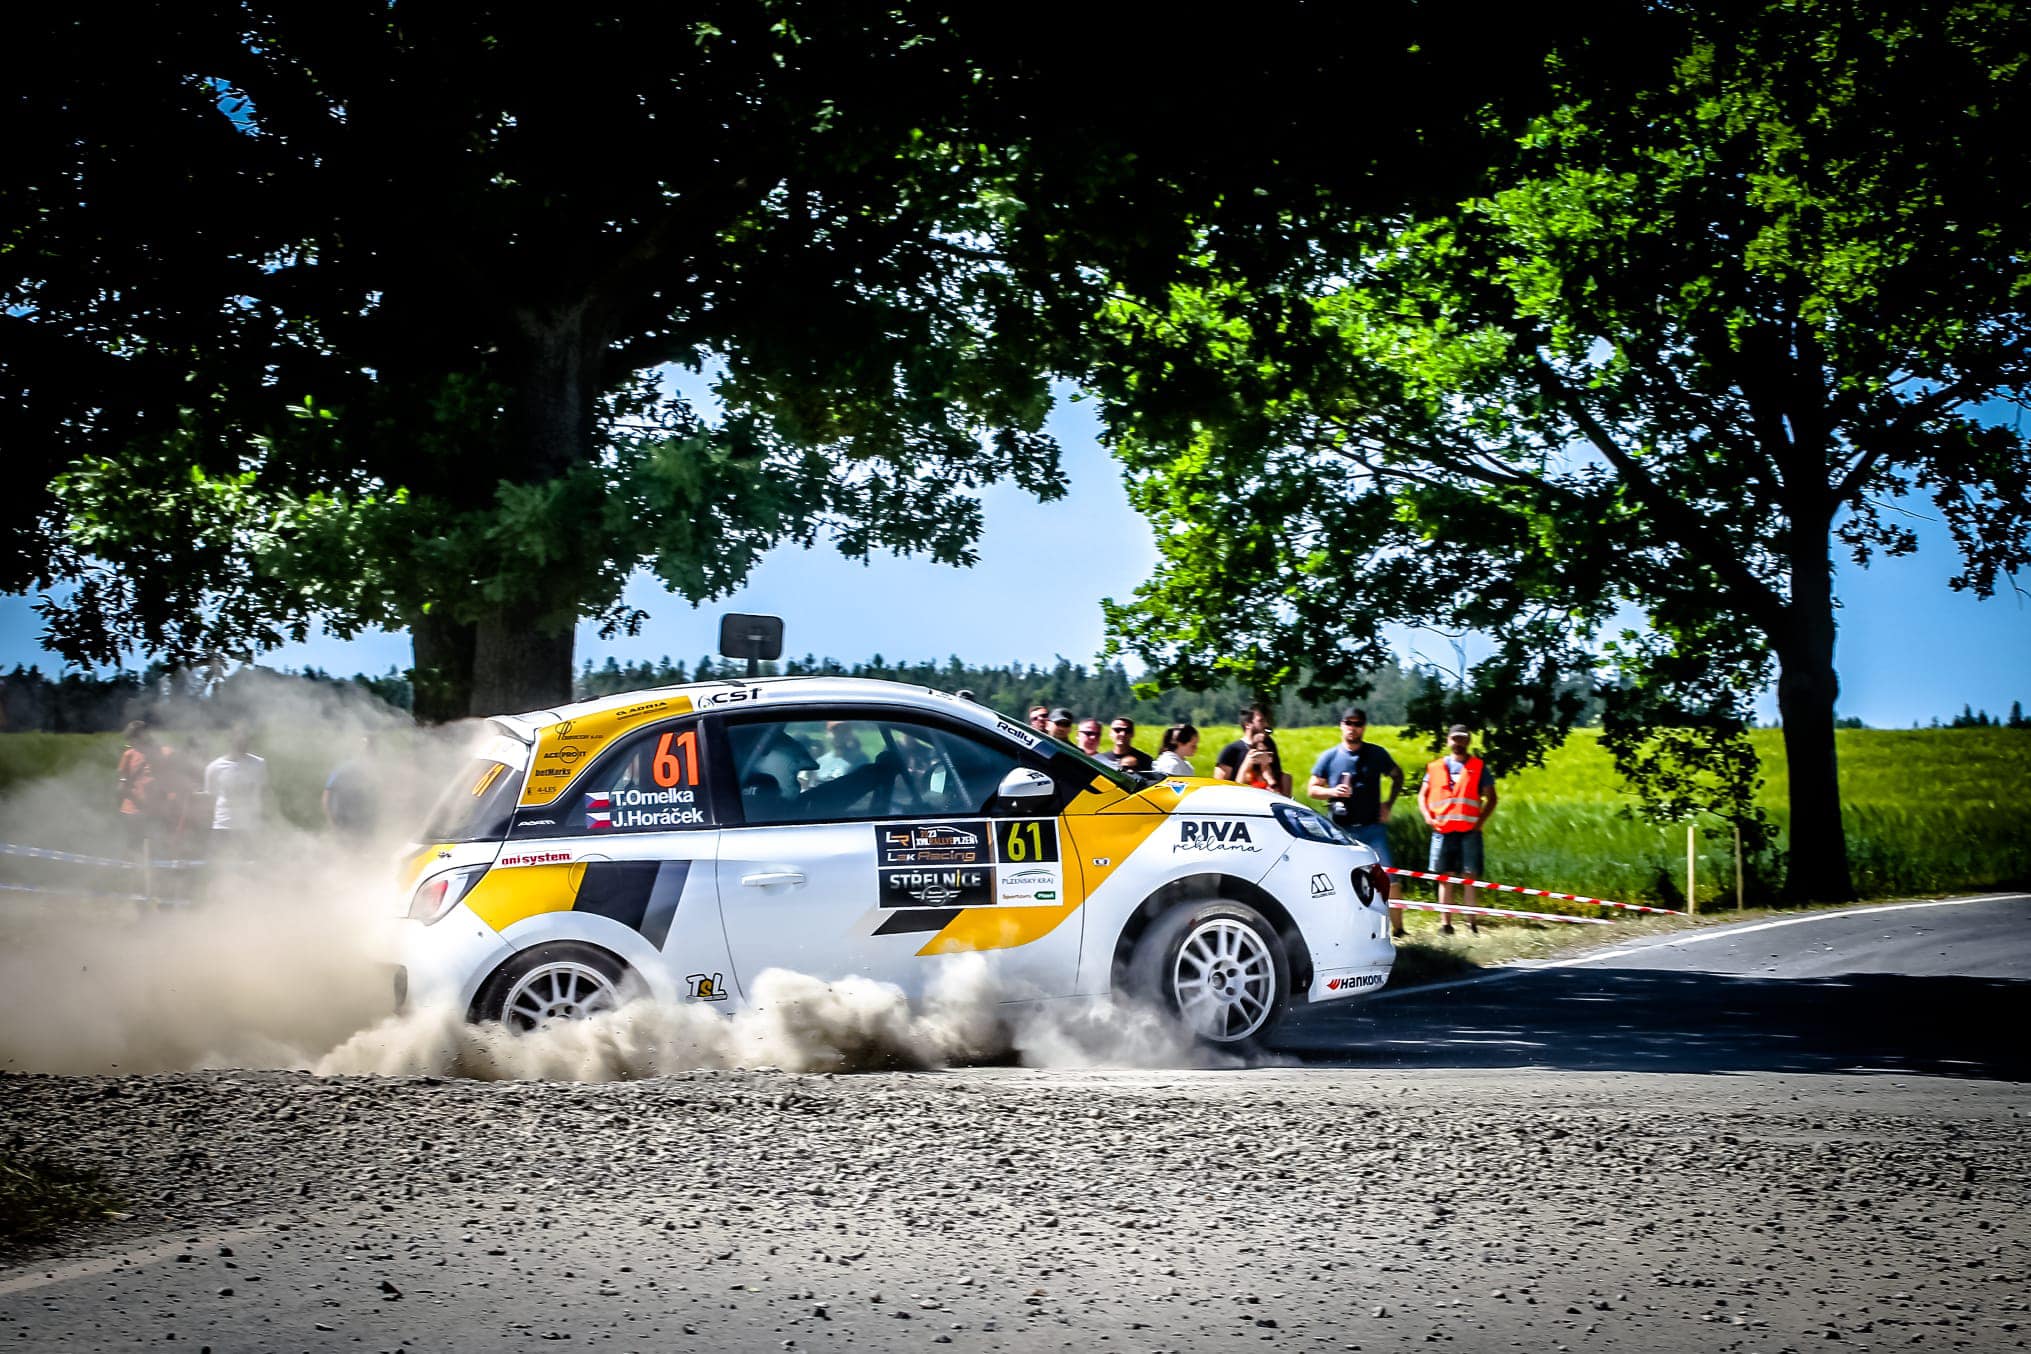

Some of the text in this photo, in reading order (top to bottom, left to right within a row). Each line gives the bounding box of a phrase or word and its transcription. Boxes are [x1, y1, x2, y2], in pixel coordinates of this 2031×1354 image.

[996, 721, 1035, 746] Rally
[652, 731, 700, 788] 61
[610, 787, 695, 806] T.Omelka
[612, 806, 705, 828] J.Horáček
[1007, 822, 1044, 862] 61
[1180, 820, 1253, 844] RIVA
[1172, 834, 1264, 854] reklama
[917, 850, 976, 863] Racing
[889, 869, 982, 890] STŘELNICE
